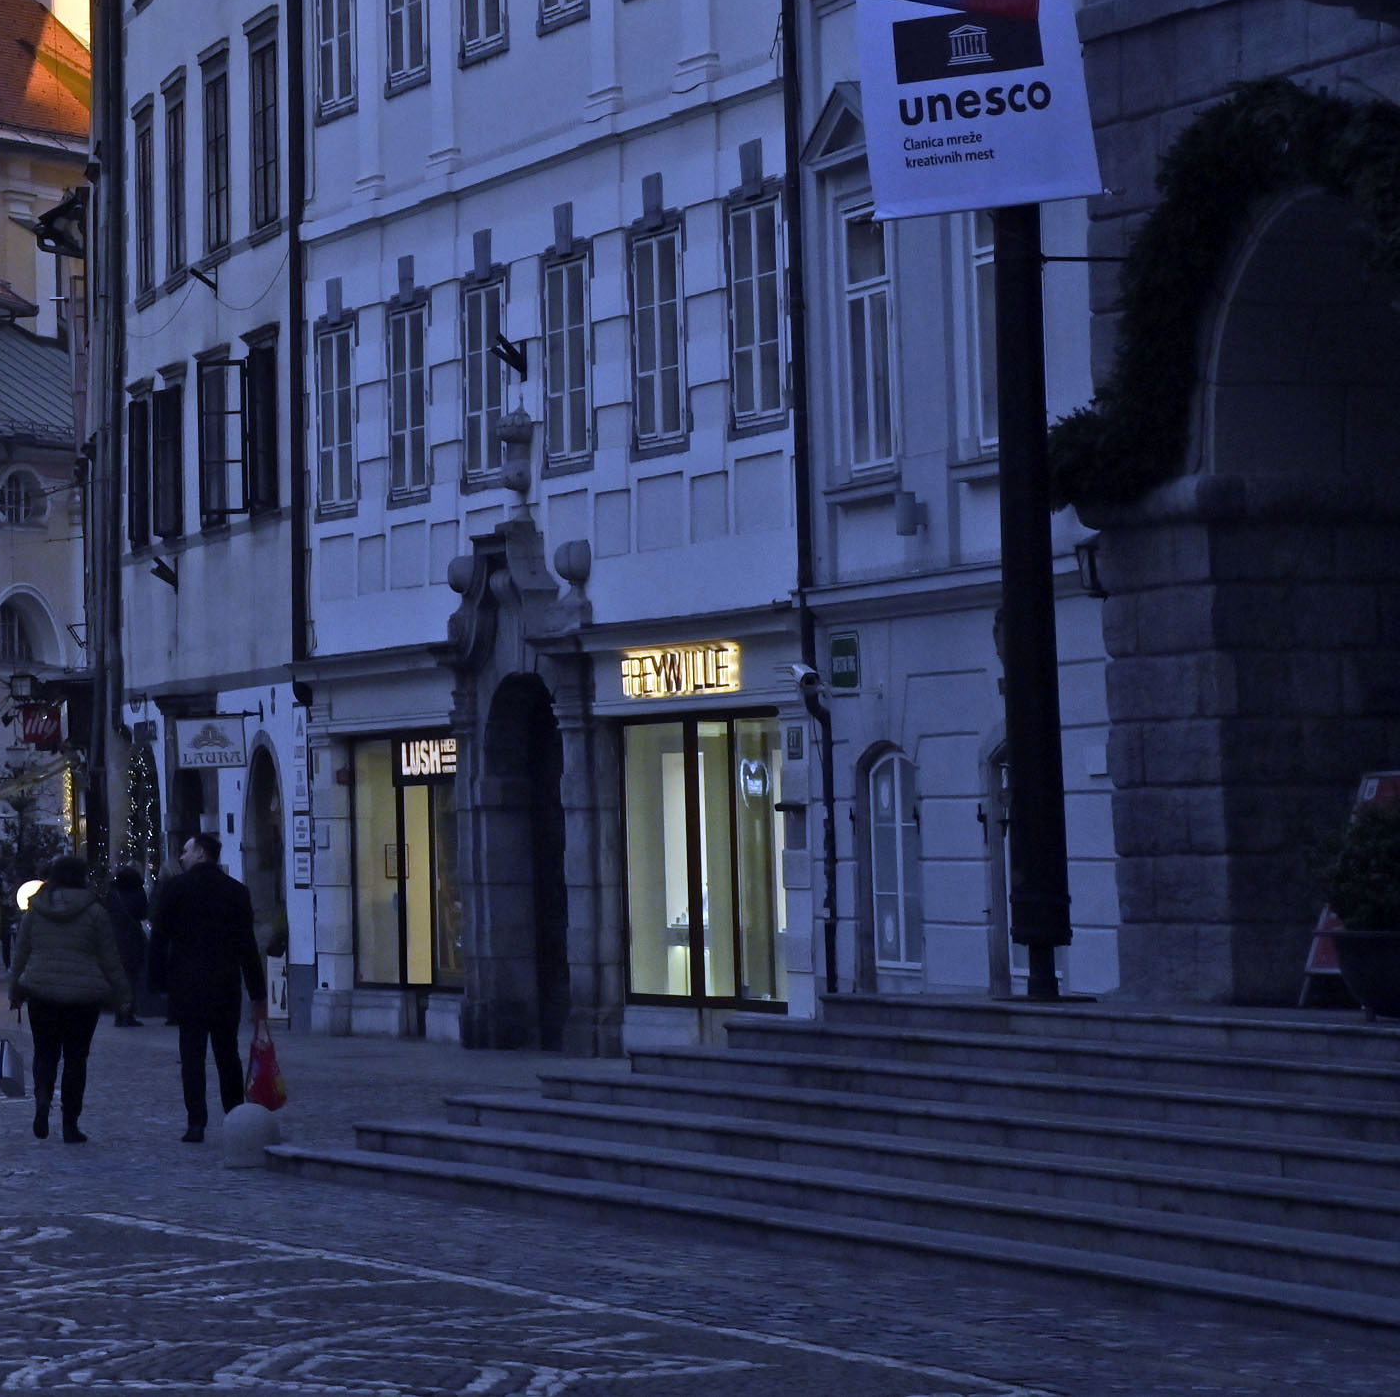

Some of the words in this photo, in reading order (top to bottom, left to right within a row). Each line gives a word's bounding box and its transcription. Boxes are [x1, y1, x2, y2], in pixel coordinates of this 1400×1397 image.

[899, 81, 1051, 125] unesco
[903, 136, 944, 151] Članica
[946, 131, 982, 145] mreže
[905, 153, 962, 168] kreativnih
[965, 149, 995, 162] mest
[183, 751, 242, 765] LAURA
[402, 740, 441, 776] LUSH
